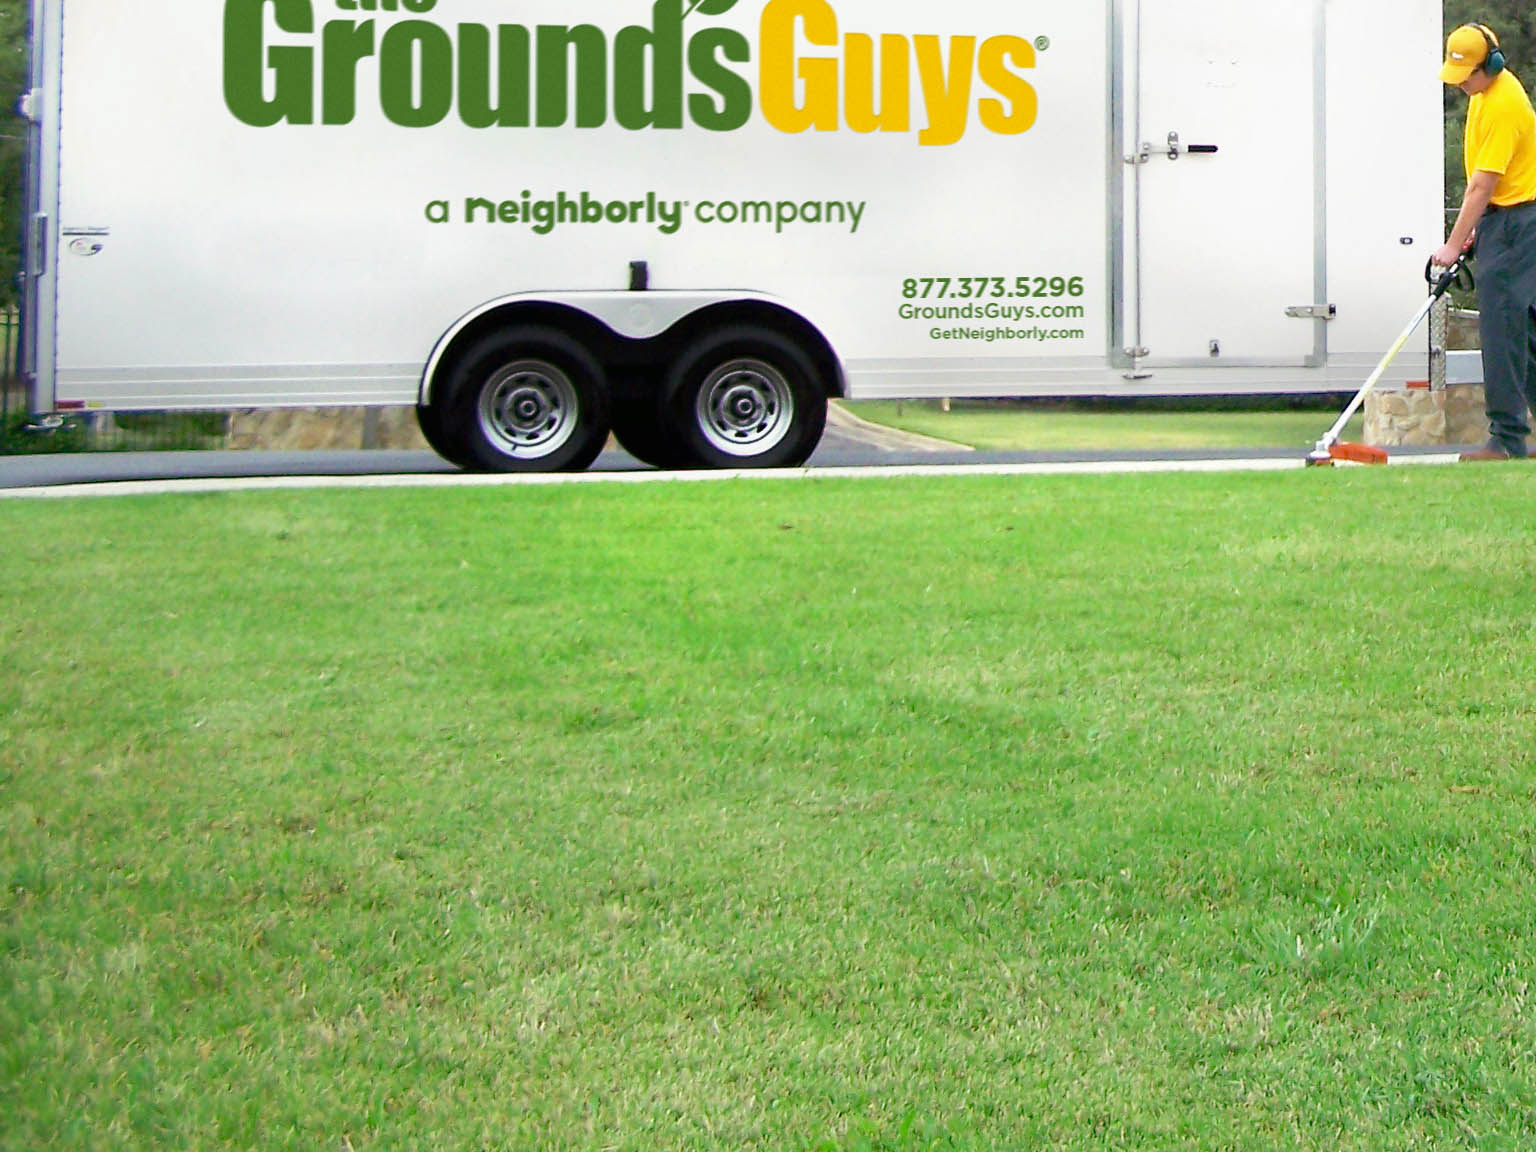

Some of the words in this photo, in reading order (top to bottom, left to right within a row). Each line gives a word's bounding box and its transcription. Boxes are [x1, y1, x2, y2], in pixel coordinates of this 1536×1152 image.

[425, 200, 449, 223] a
[464, 190, 682, 234] neighborly
[694, 200, 866, 233] company
[902, 276, 1084, 299] 877.373.5296
[898, 302, 1084, 321] GroundsGuys.com
[929, 326, 1084, 342] GetNeighborly.com
